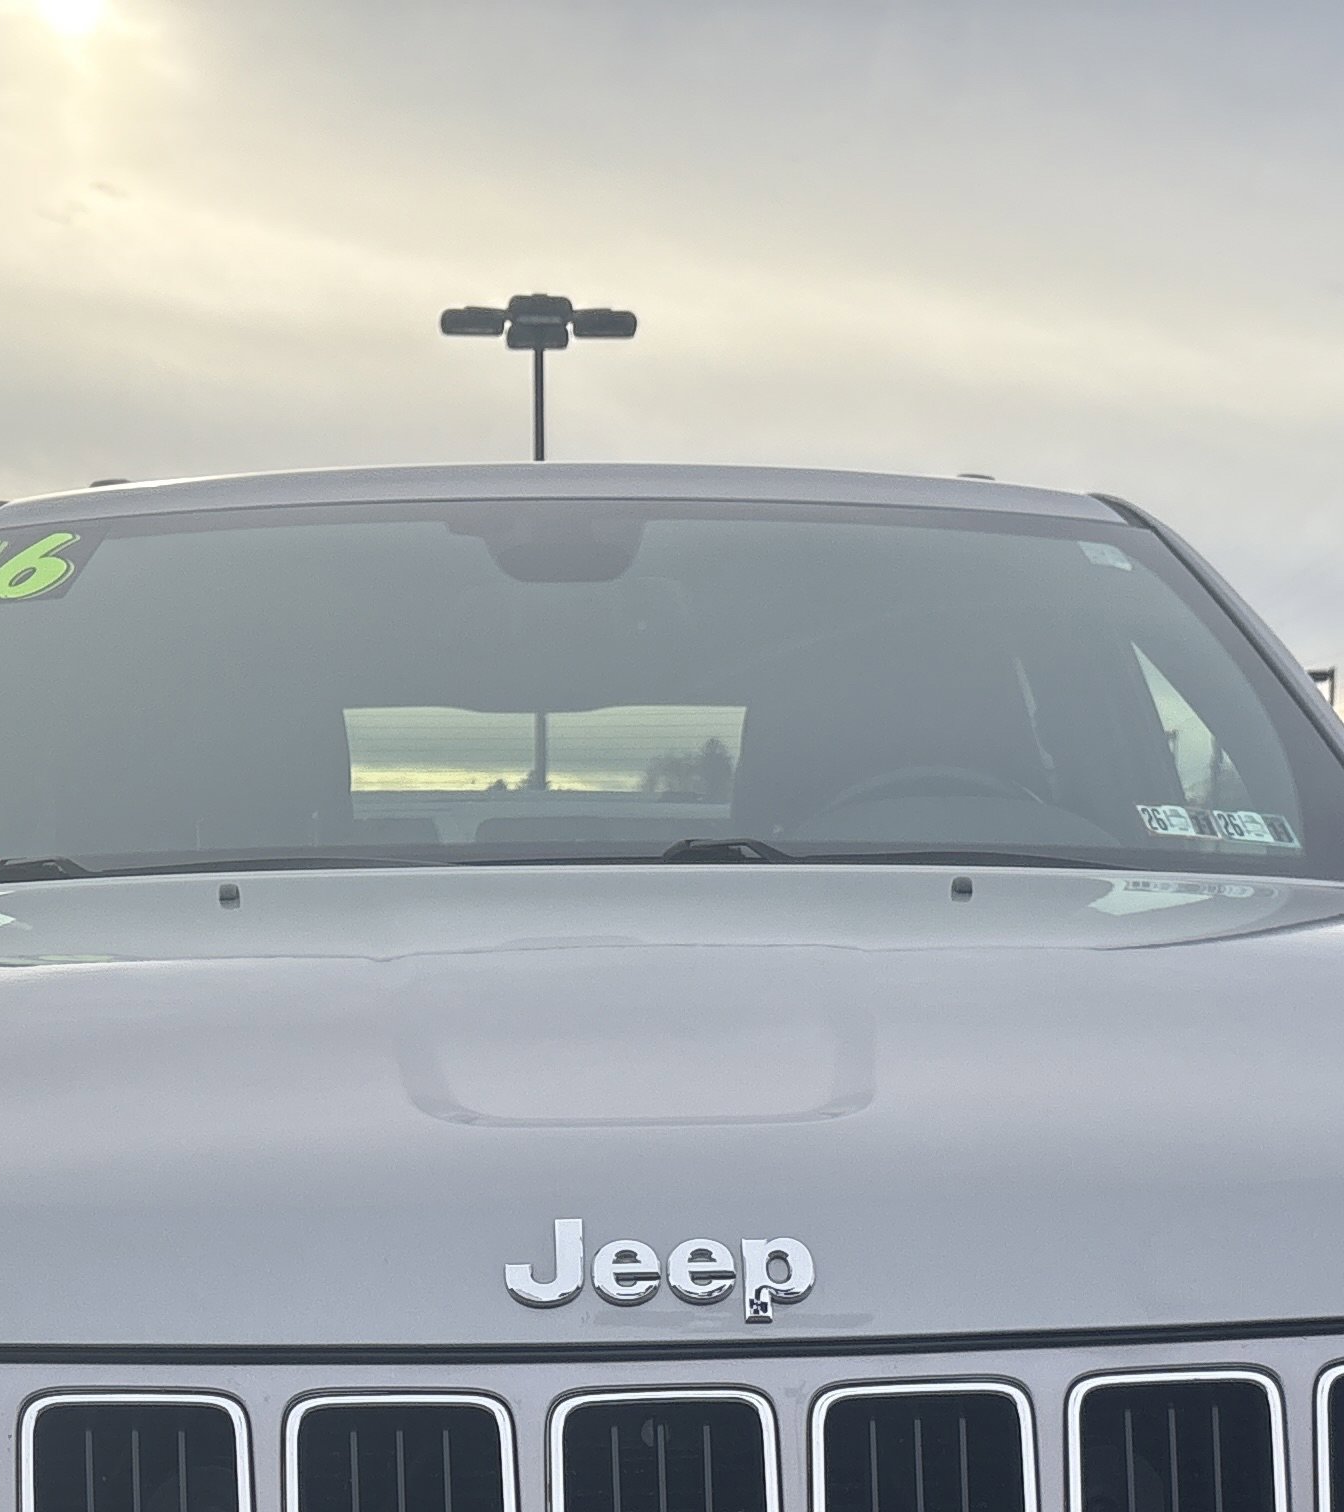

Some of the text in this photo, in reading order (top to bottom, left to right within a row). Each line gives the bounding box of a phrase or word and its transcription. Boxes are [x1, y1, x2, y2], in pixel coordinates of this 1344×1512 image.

[1141, 807, 1168, 831] 26
[1217, 812, 1245, 838] 26
[505, 1218, 815, 1324] Jeep
